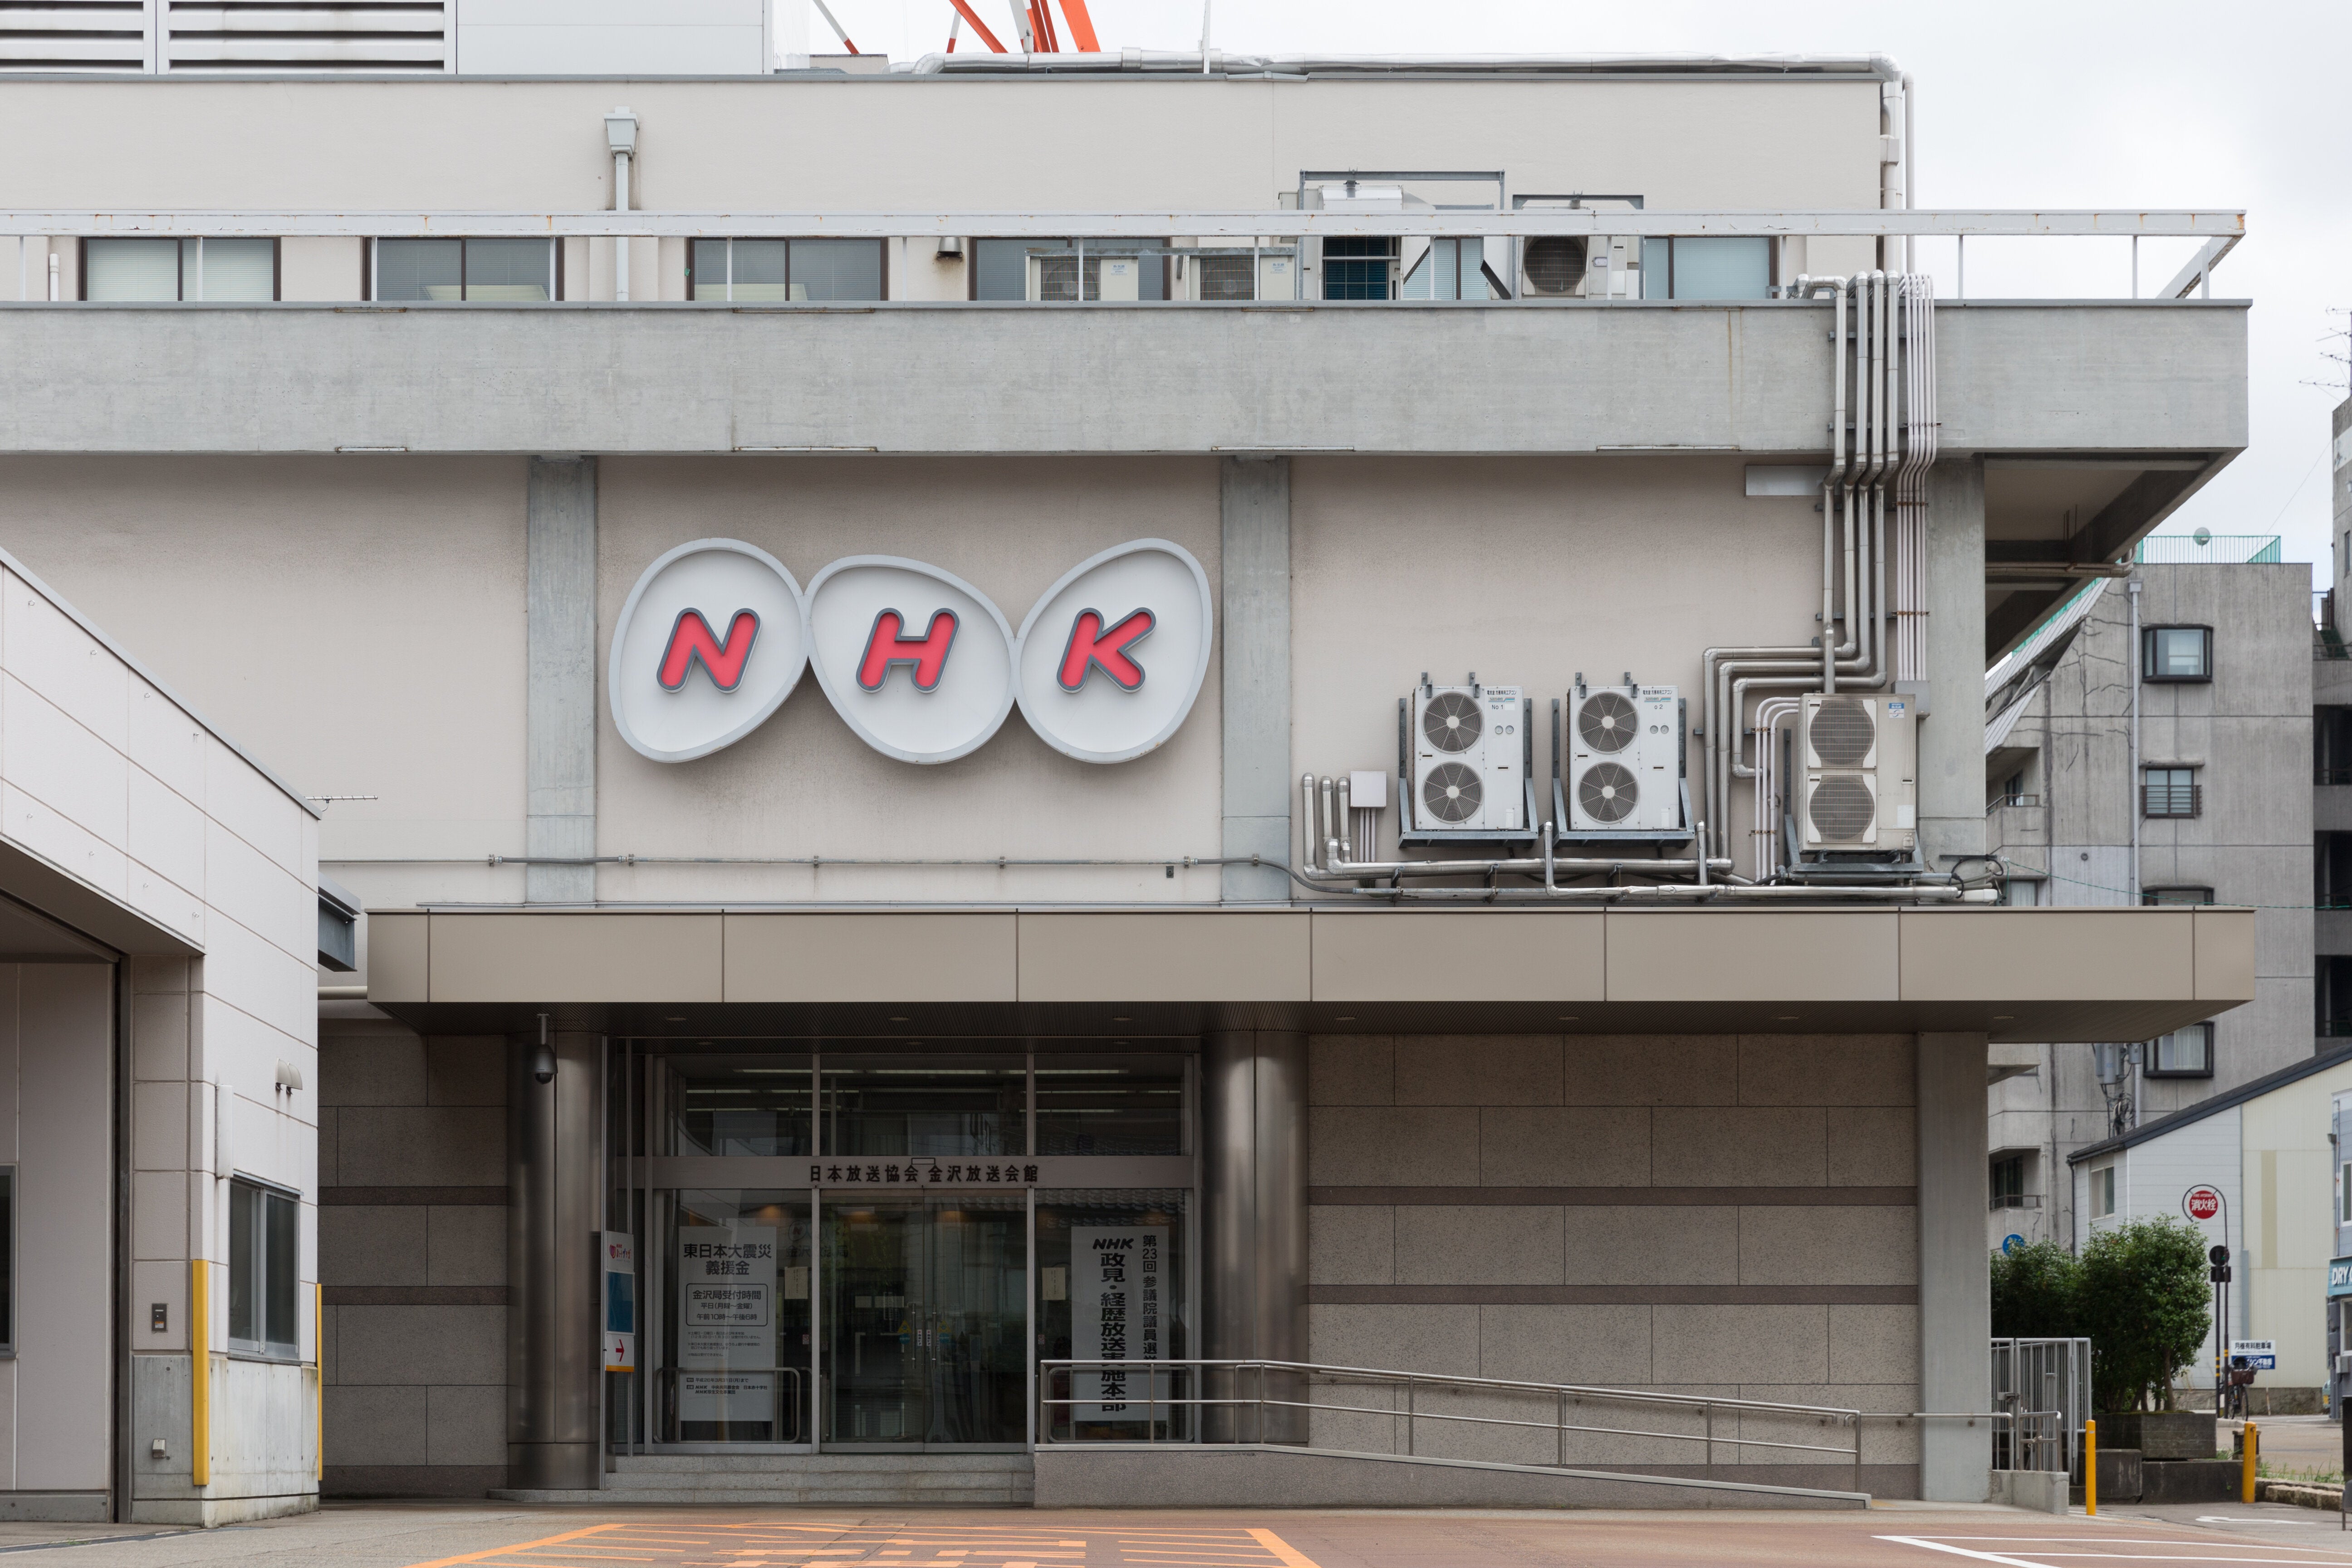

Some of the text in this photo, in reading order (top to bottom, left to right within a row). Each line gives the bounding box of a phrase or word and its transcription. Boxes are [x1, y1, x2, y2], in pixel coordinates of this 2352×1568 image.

[657, 607, 1156, 694] NHK
[810, 1165, 1039, 1182] 日本放送協会 金沢放送会館
[2191, 1199, 2216, 1211] 消火栓
[683, 1243, 772, 1259] 東日本大震災
[1093, 1238, 1134, 1250] NHK
[706, 1260, 750, 1275] 義援金
[2331, 1266, 2350, 1285] DRY
[692, 1290, 761, 1300] 金沢局受付時間
